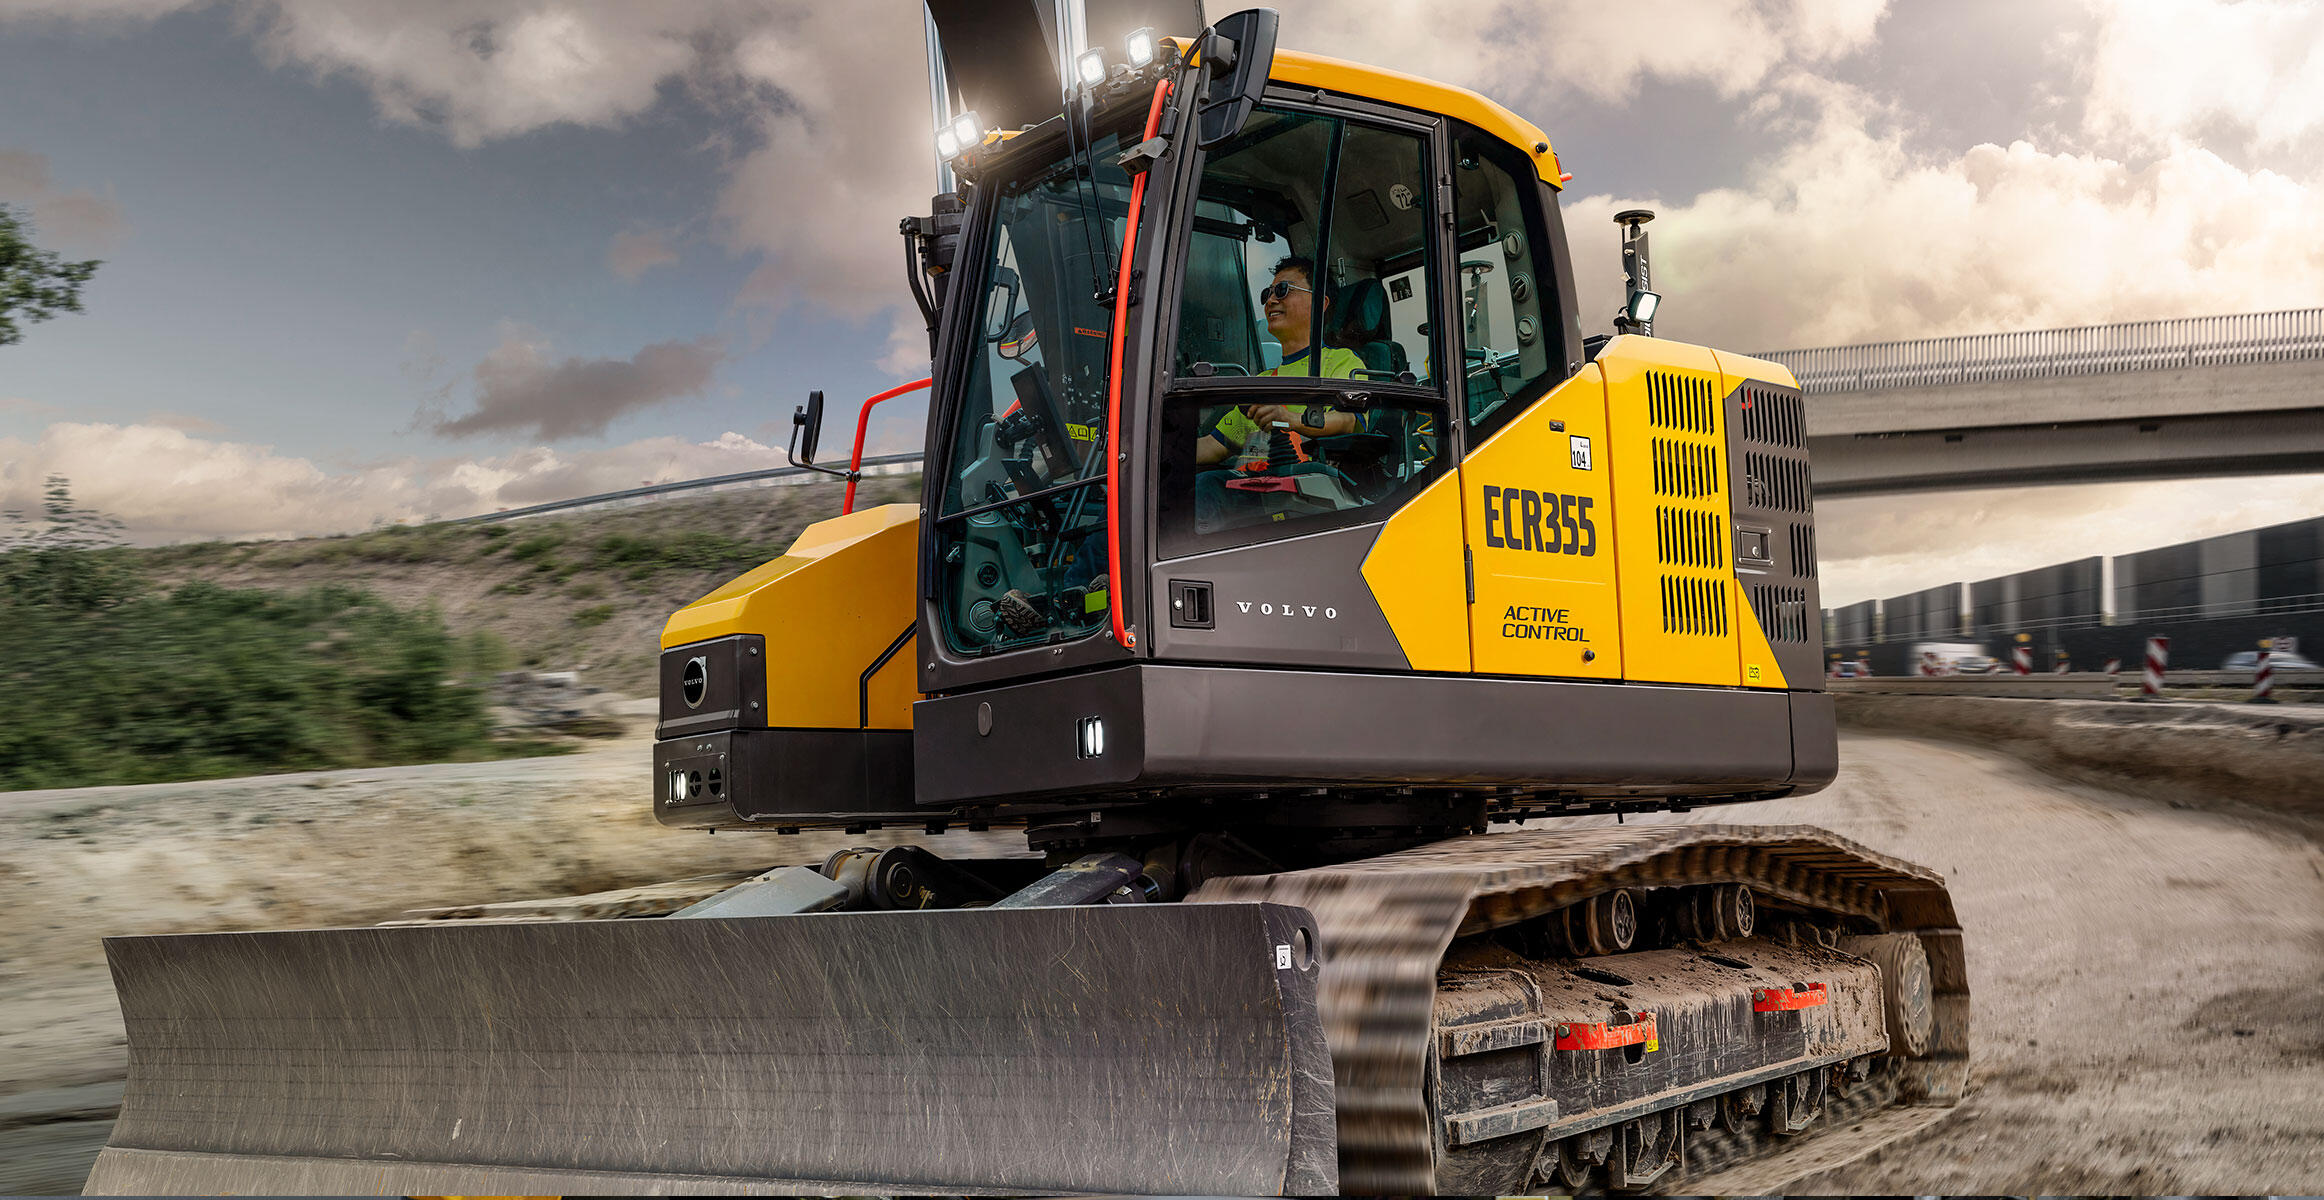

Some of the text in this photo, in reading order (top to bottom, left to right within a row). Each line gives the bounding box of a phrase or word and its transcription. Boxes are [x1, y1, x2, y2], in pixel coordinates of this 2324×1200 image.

[1572, 450, 1587, 467] 104
[1484, 485, 1596, 557] ECR355
[1236, 601, 1338, 619] VOLVO
[1504, 605, 1570, 624] ACTIVE
[1502, 623, 1590, 643] CONTROL
[684, 677, 703, 686] VOLVO
